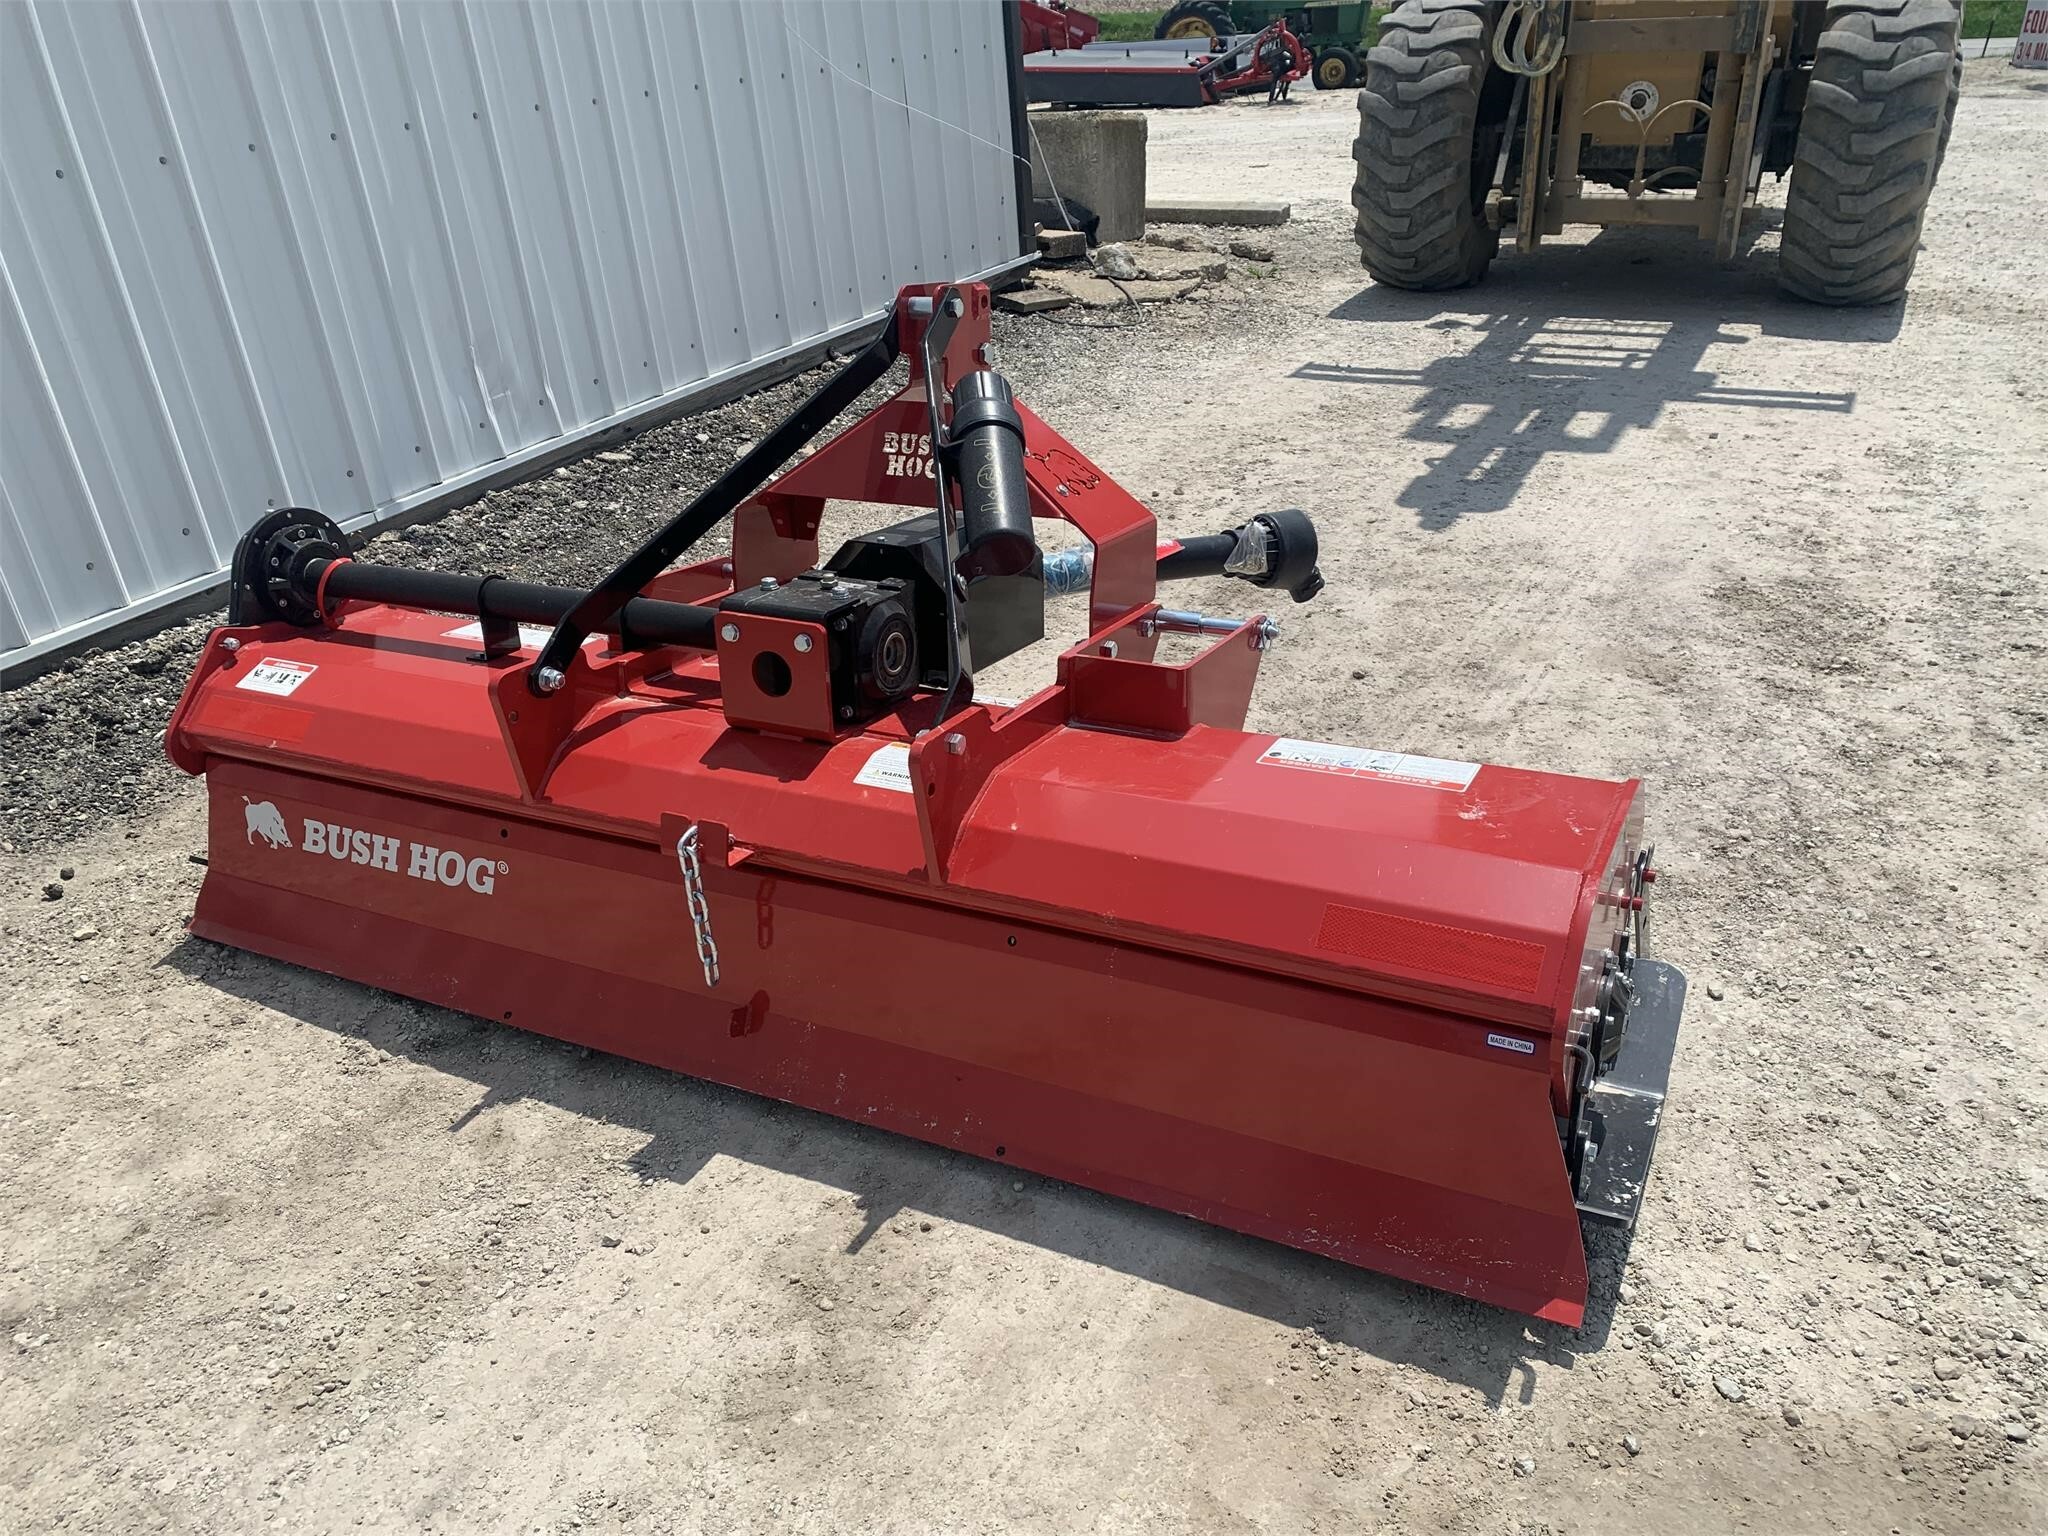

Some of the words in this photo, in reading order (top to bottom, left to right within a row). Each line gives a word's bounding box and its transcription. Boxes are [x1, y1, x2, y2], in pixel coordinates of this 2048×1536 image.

[2023, 10, 2048, 33] EQU
[882, 431, 933, 456] BUS
[881, 770, 912, 780] WARNIN
[302, 818, 400, 873] BUSH
[1490, 1036, 1507, 1046] MADE
[1514, 1041, 1532, 1051] CHINA
